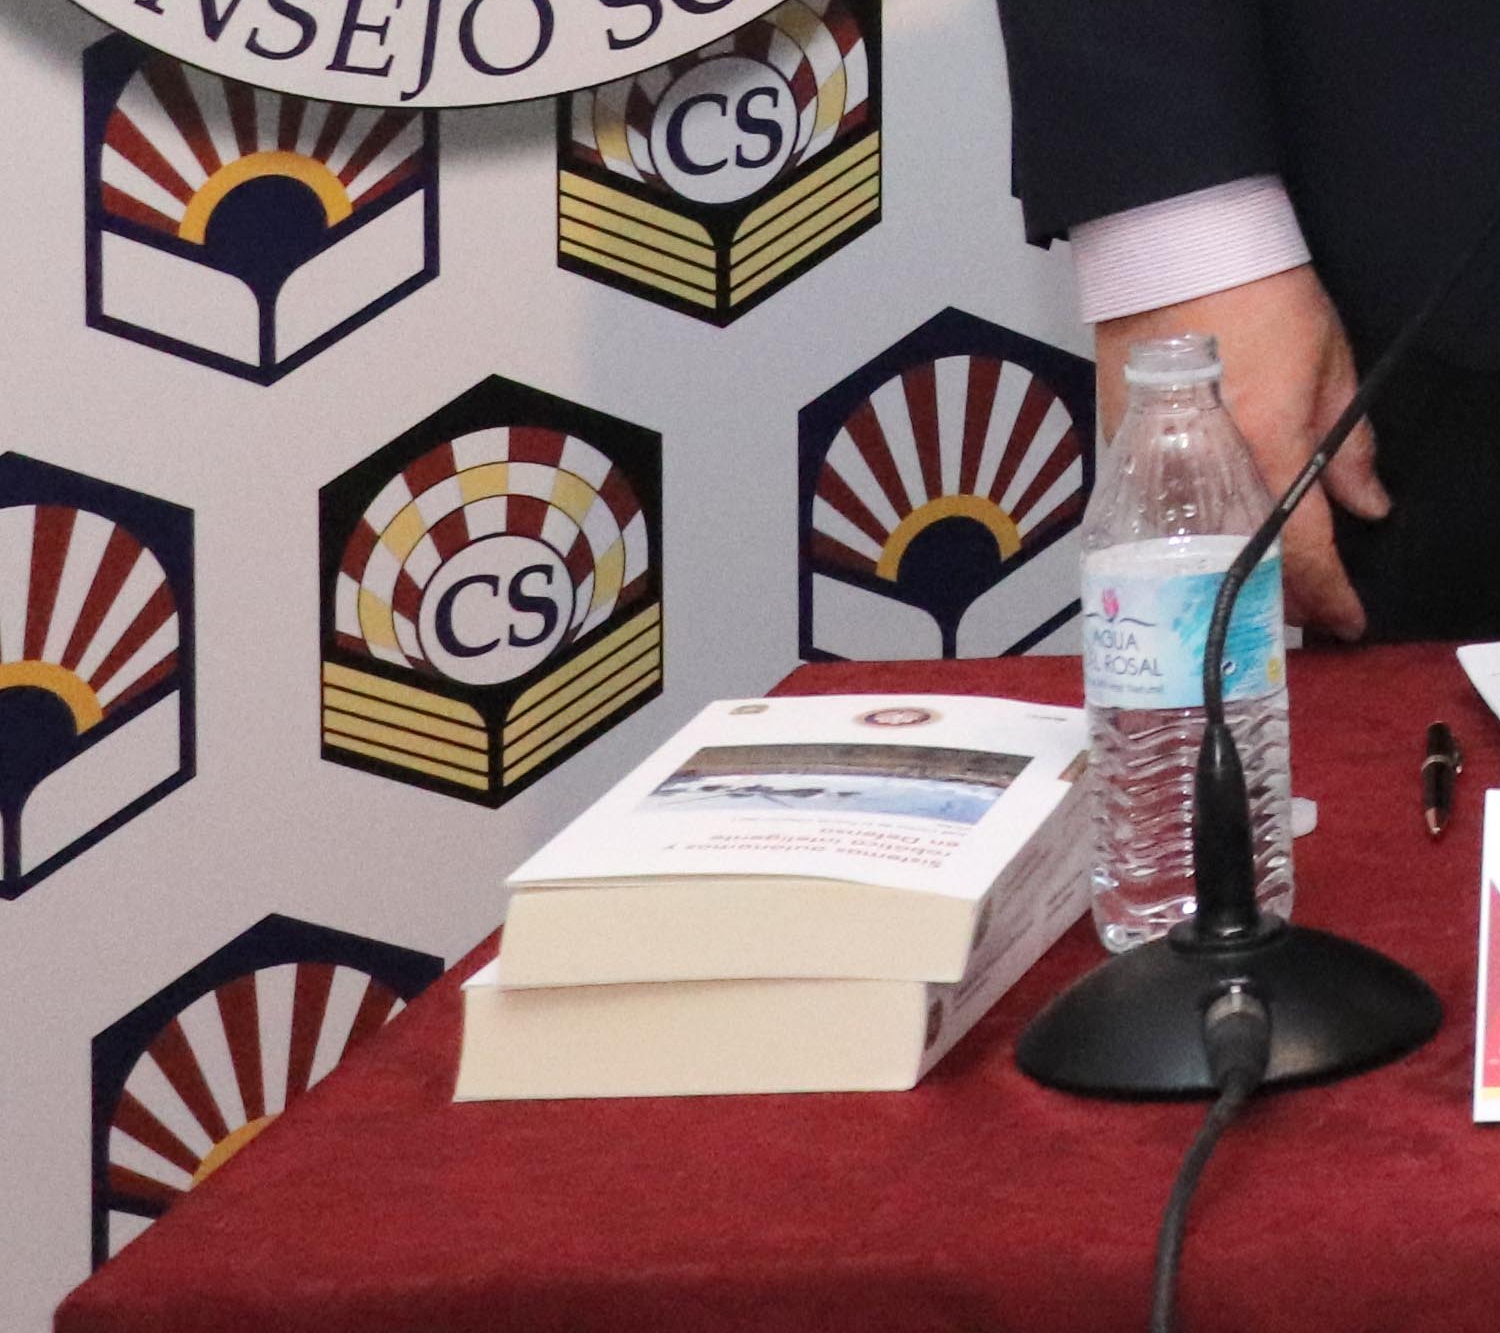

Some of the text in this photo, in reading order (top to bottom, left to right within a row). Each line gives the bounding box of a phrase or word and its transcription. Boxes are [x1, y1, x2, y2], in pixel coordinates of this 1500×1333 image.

[665, 88, 785, 177] CS
[434, 564, 559, 657] CS
[1104, 653, 1164, 677] ROSAL
